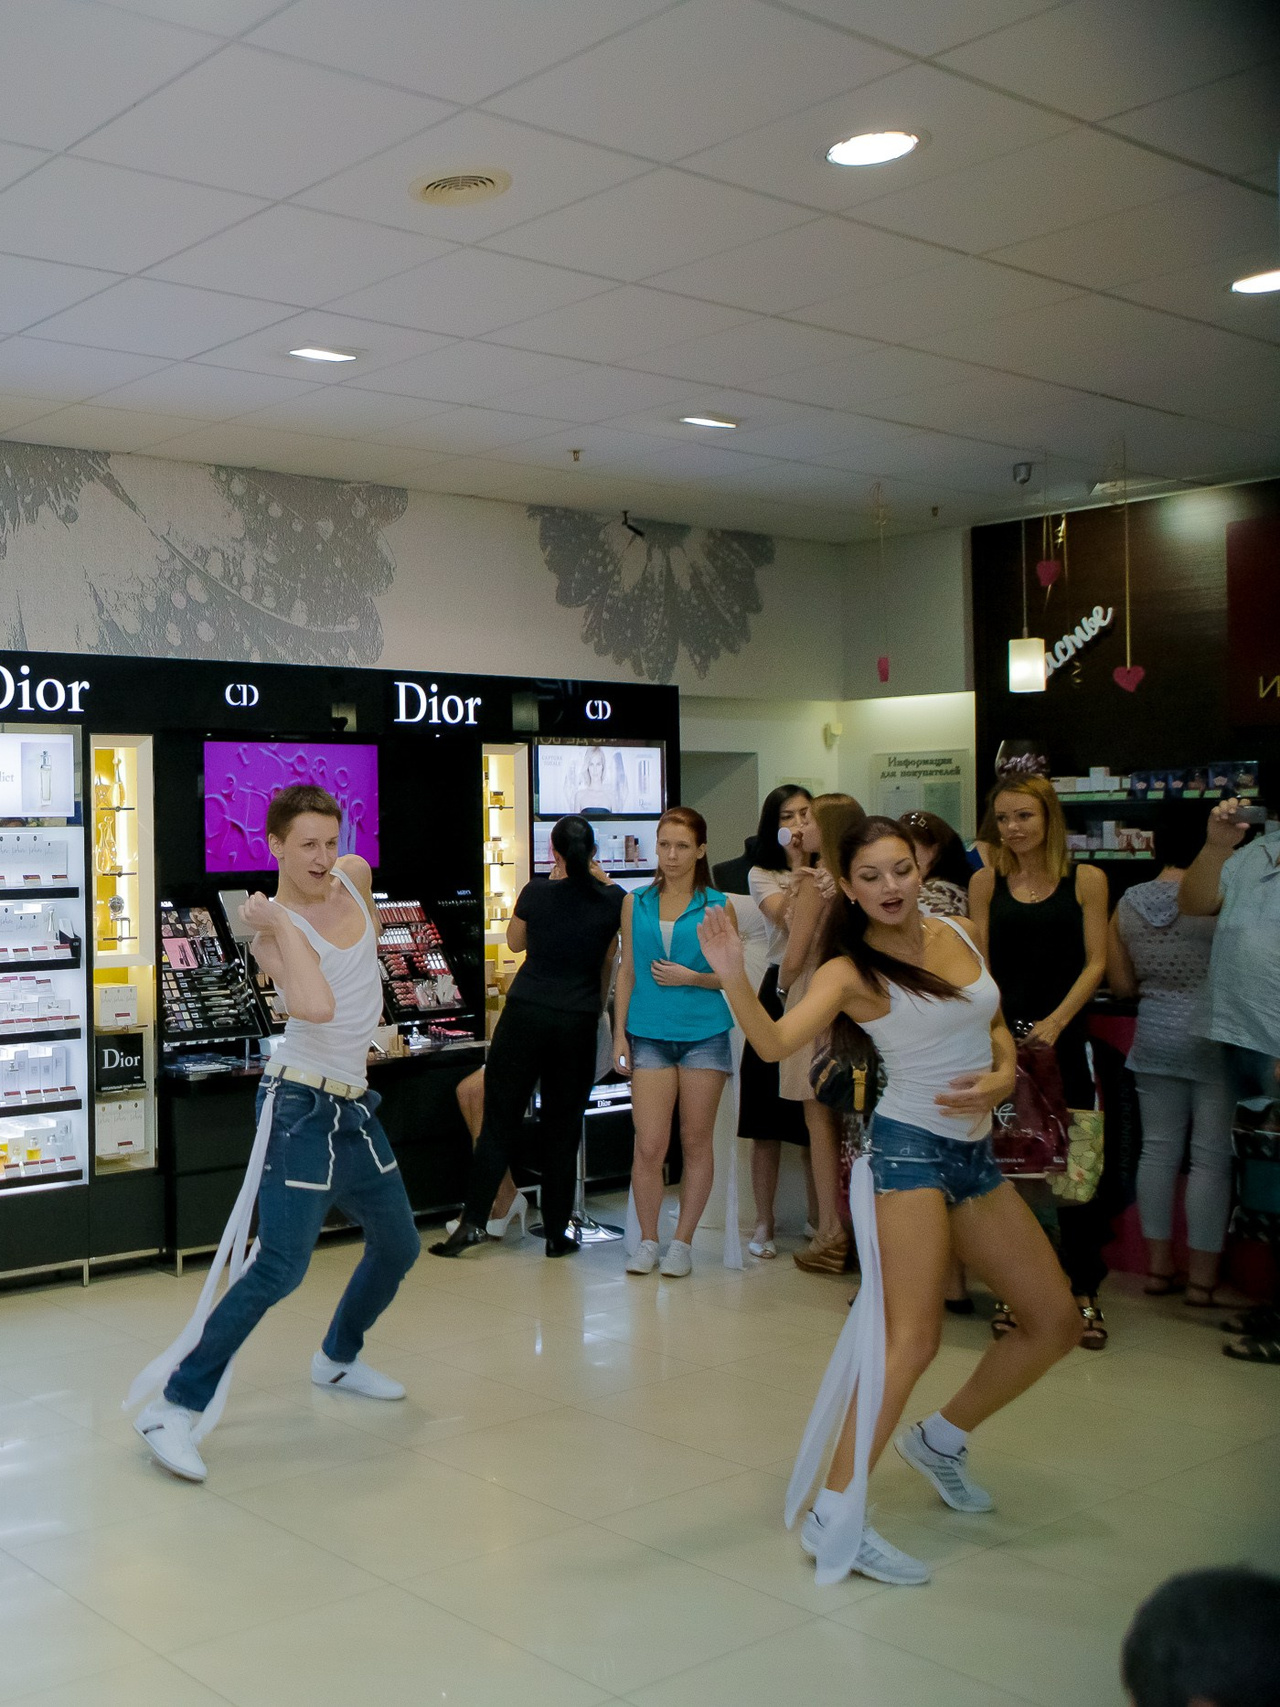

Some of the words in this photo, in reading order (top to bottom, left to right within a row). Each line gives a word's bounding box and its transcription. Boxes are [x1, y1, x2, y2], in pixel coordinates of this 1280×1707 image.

[394, 682, 481, 724] Dior
[888, 757, 952, 768] Информация
[880, 771, 897, 779] для
[901, 766, 961, 778] покупателей
[102, 1048, 141, 1070] Dior
[597, 1099, 612, 1107] Dior
